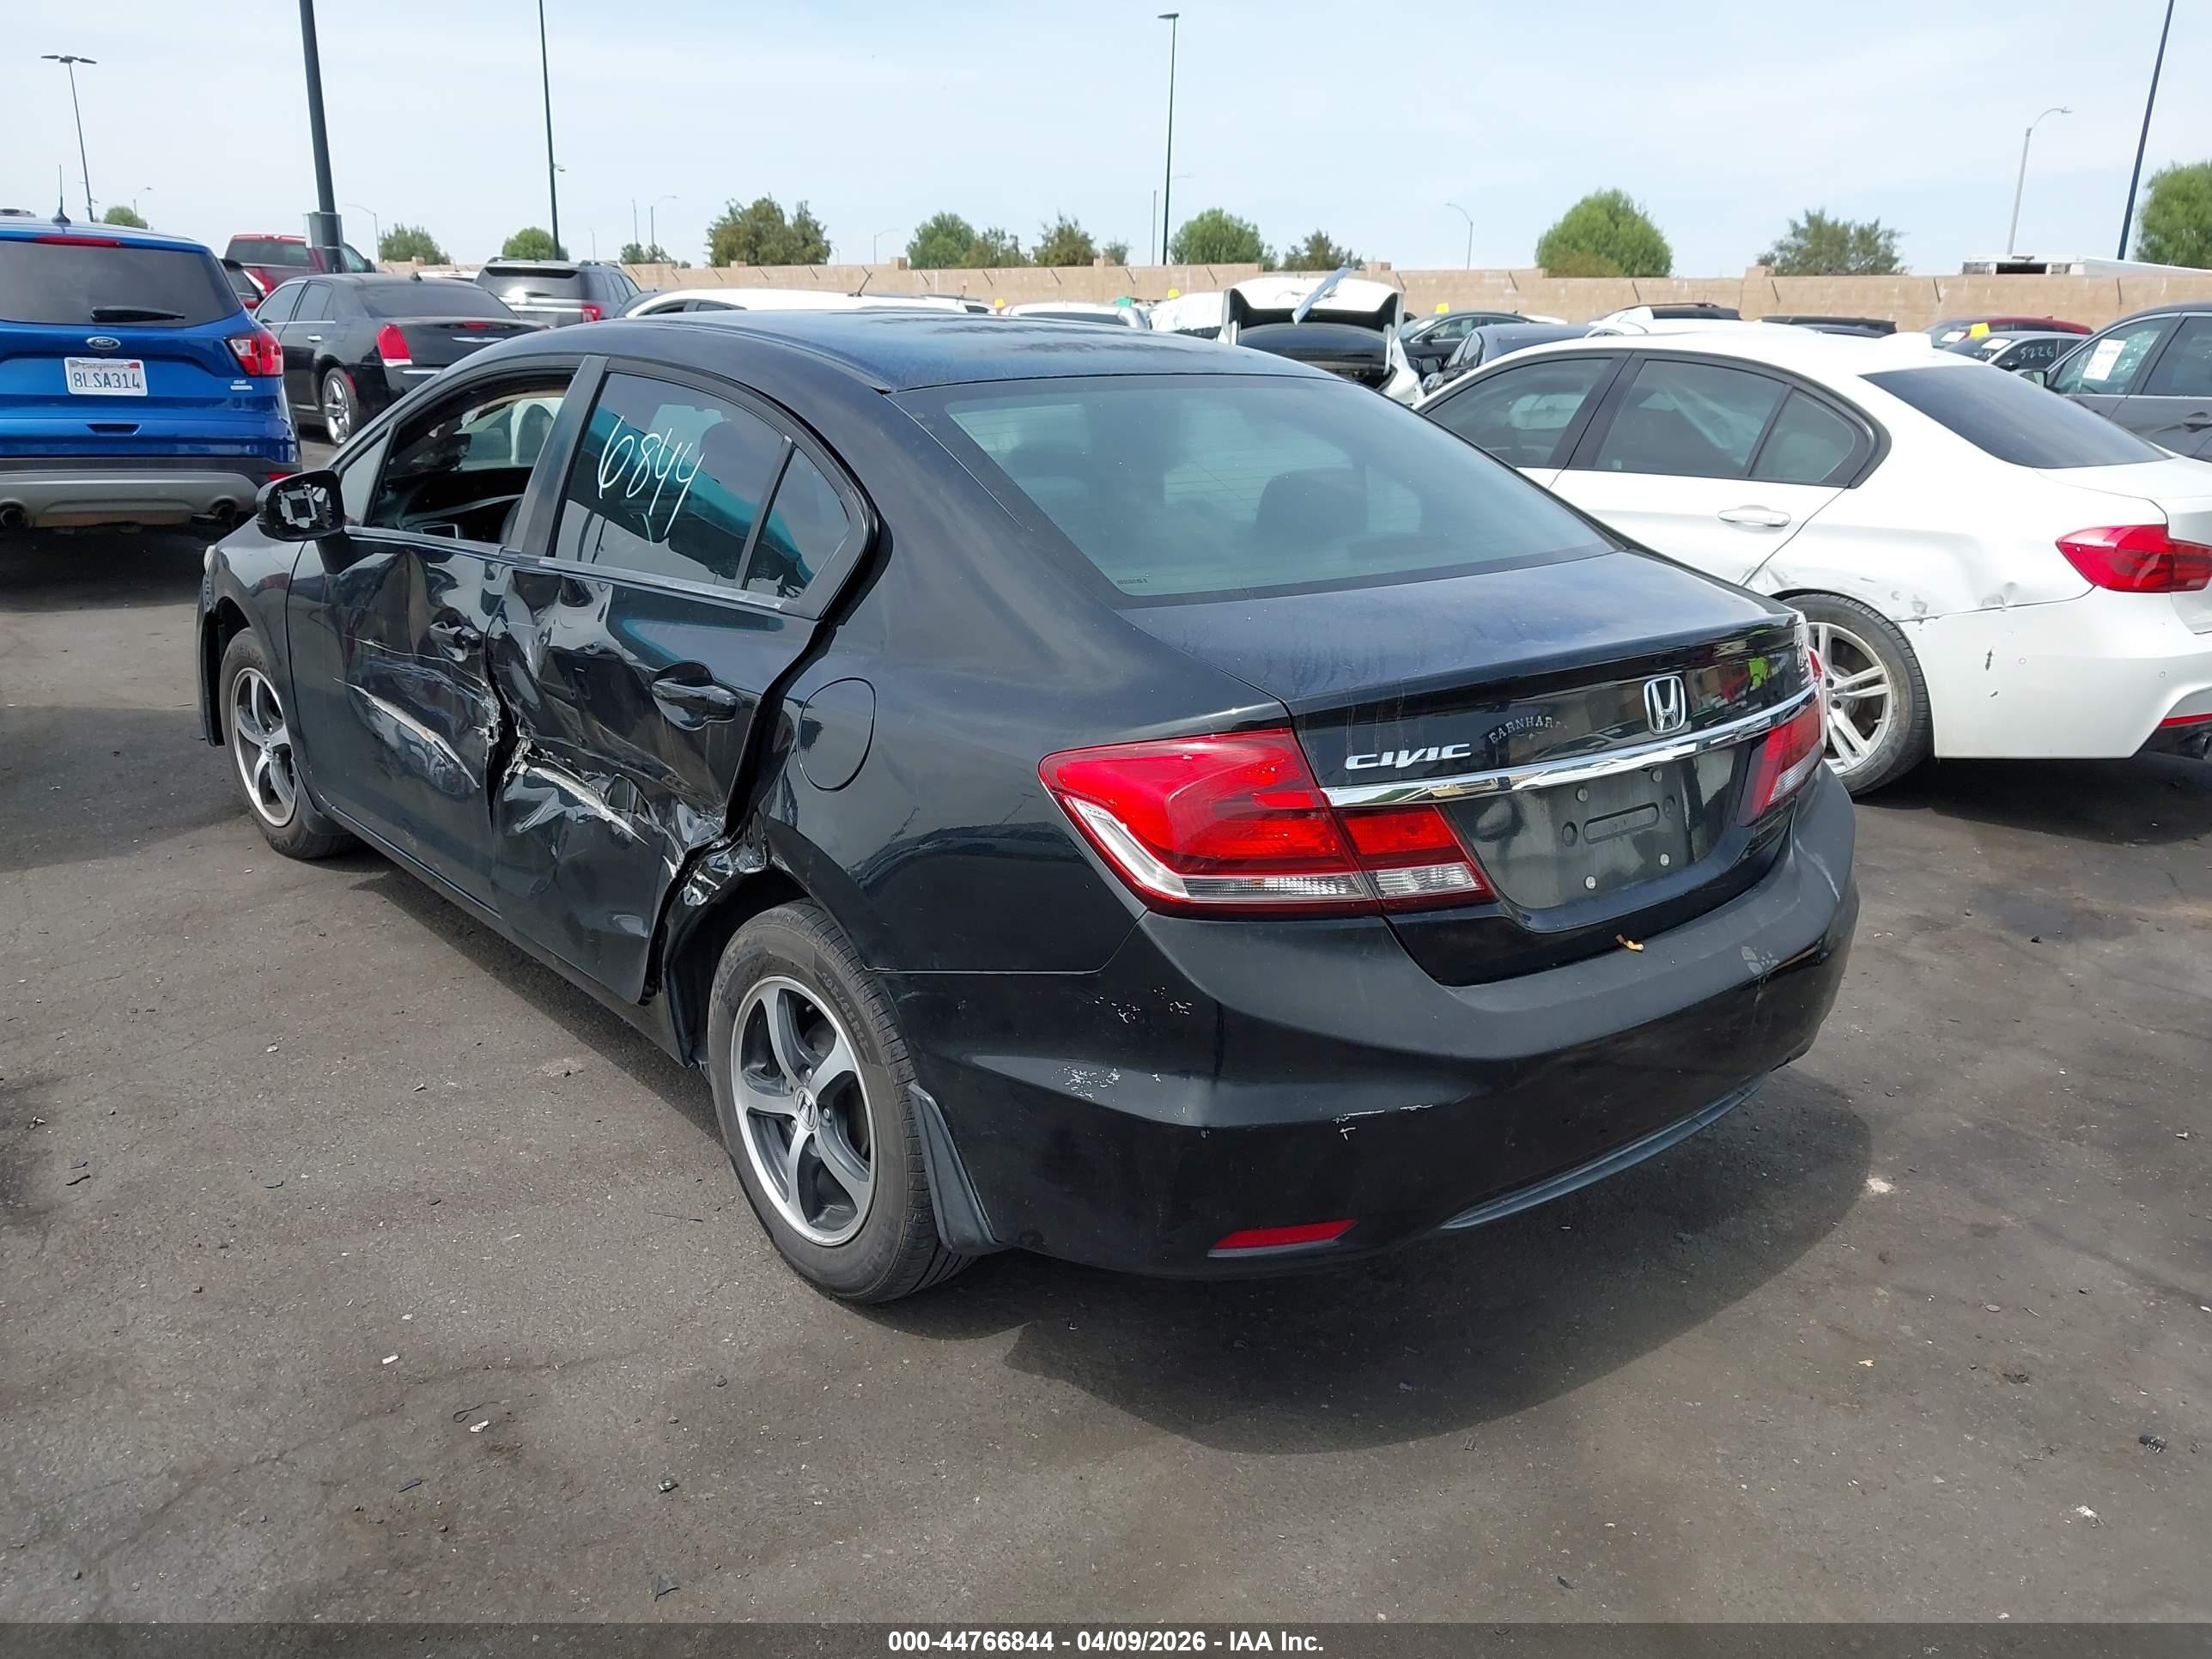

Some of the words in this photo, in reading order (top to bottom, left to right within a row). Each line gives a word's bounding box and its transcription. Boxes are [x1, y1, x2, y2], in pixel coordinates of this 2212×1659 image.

[73, 372, 141, 389] 8LSA314
[598, 415, 706, 537] 6844
[1345, 743, 1472, 770] CIVIC
